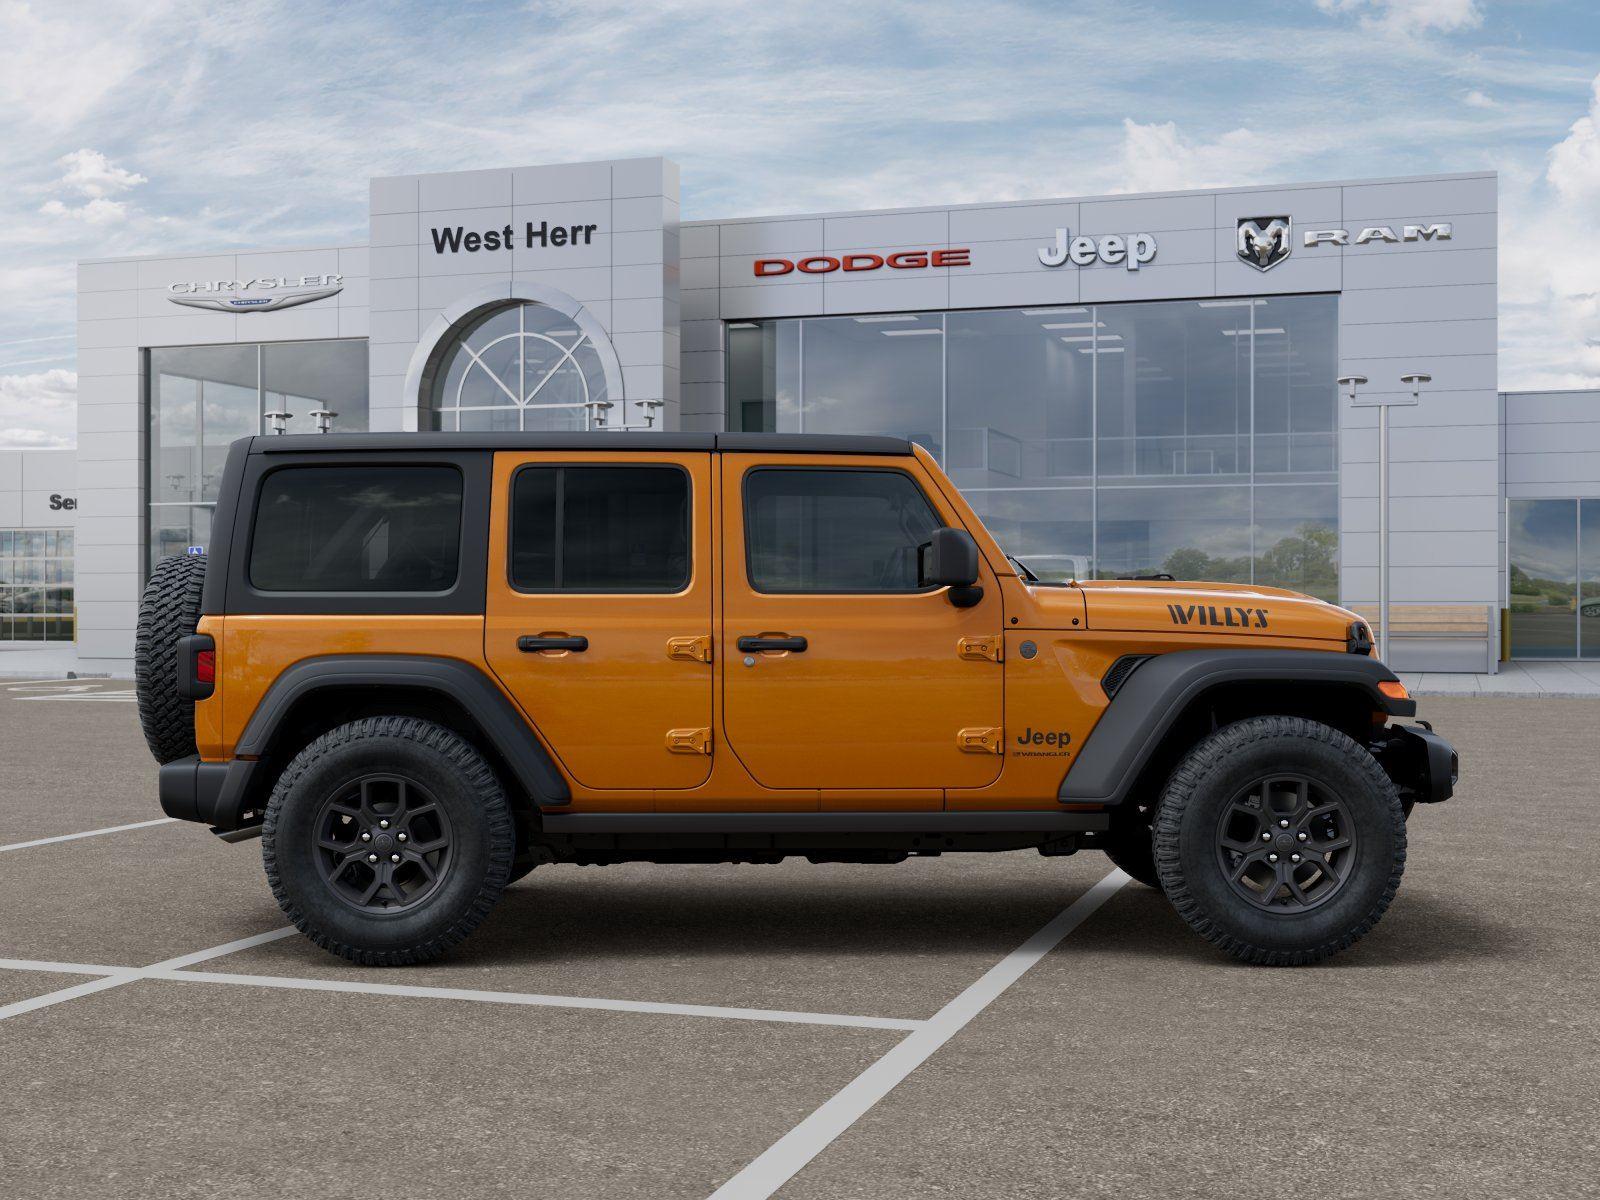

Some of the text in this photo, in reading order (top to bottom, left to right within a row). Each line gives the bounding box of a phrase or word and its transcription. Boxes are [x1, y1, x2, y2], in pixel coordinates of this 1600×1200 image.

[431, 221, 597, 254] West Herr
[1303, 223, 1453, 248] RAM
[1037, 227, 1157, 271] Jeep
[754, 248, 971, 277] DODGE
[169, 273, 344, 294] CHRYSLER
[1167, 604, 1269, 629] WILLYS
[1017, 727, 1071, 748] Jeep
